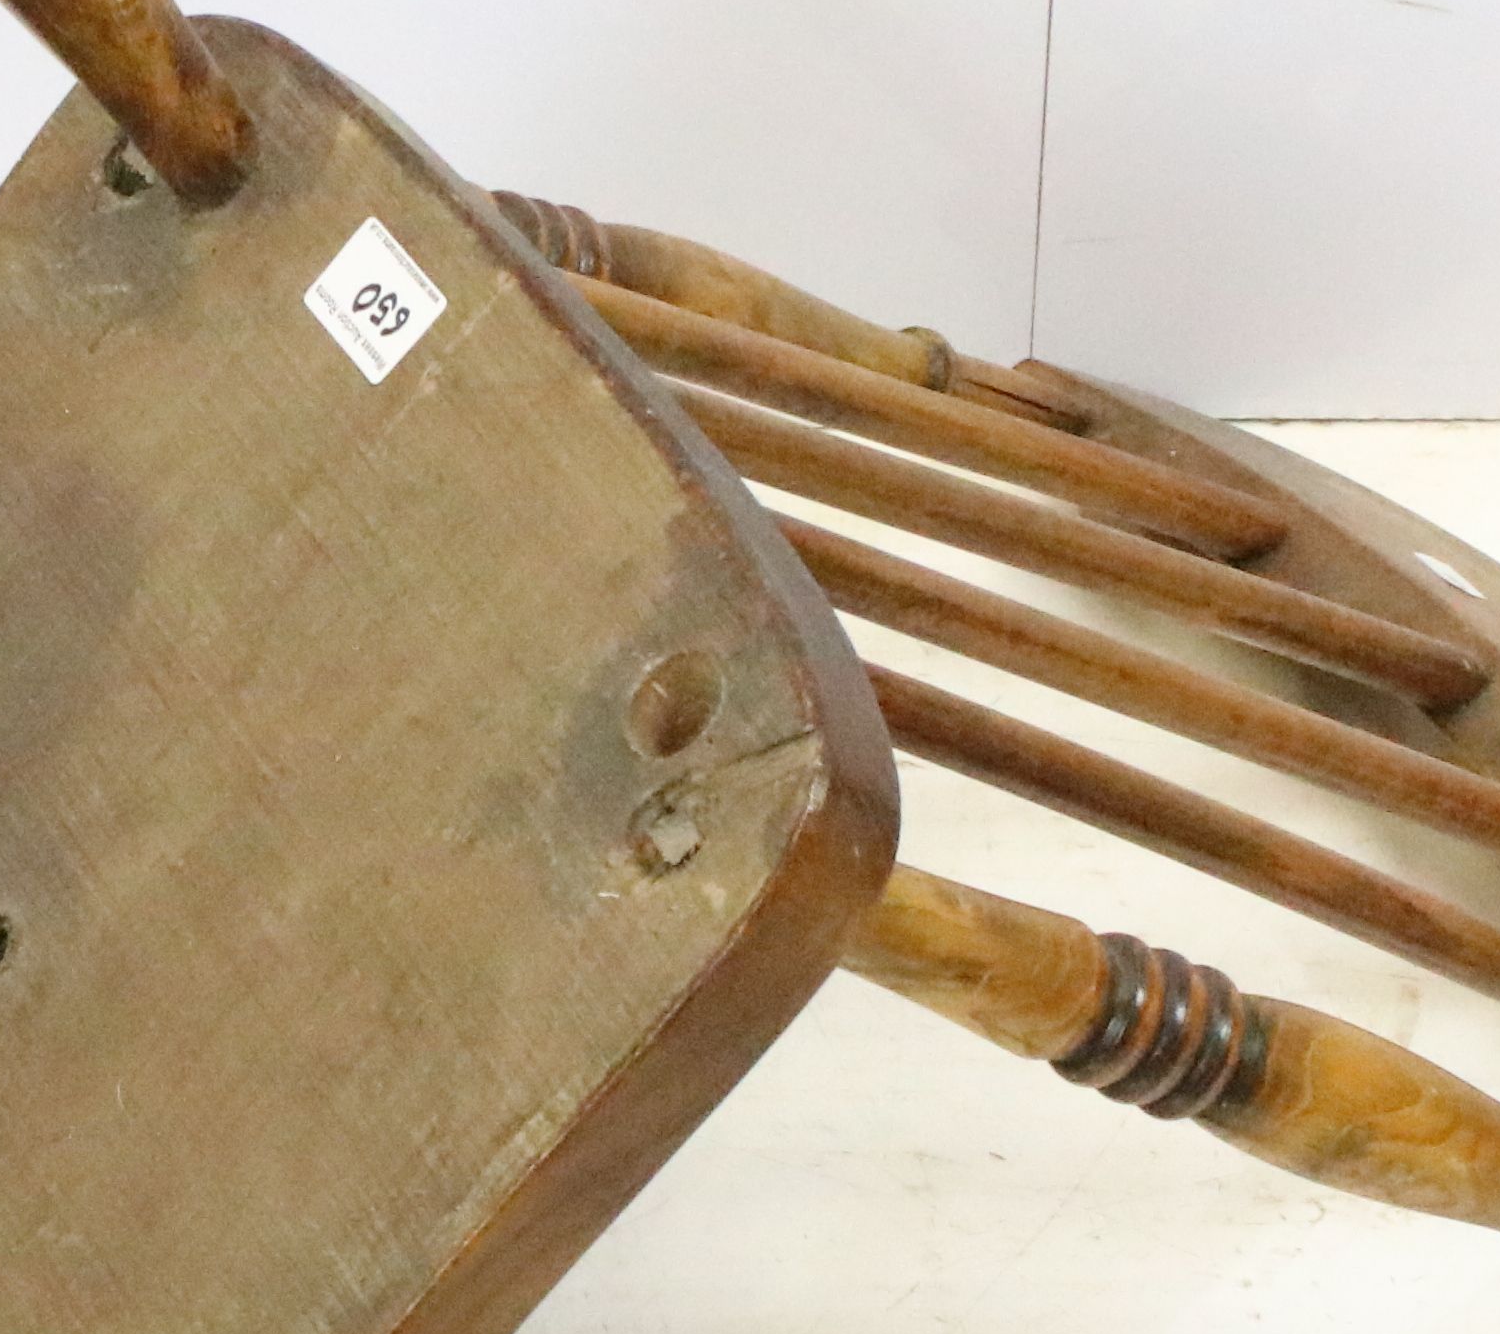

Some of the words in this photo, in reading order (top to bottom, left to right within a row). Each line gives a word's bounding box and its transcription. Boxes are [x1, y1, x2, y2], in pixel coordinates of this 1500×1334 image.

[315, 284, 337, 315] Rooms
[352, 283, 410, 336] 650
[337, 311, 362, 343] Auction
